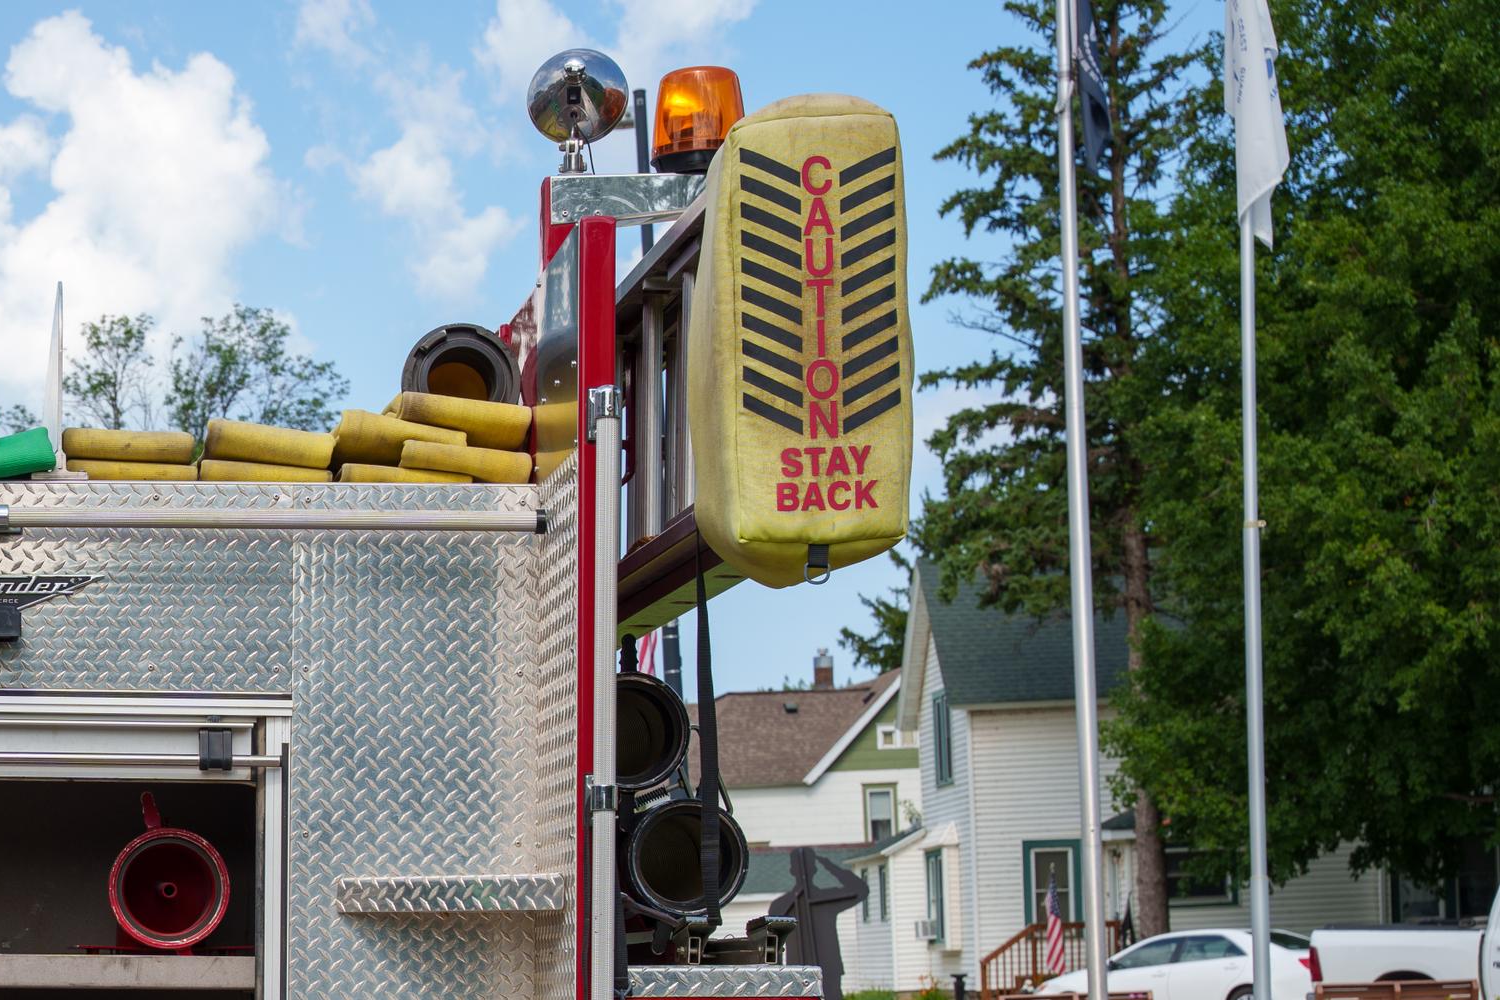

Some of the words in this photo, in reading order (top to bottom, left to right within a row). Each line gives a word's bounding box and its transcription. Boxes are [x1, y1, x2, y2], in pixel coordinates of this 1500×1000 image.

[801, 156, 839, 439] CAUTION
[781, 446, 872, 478] STAY
[776, 480, 879, 511] BACK
